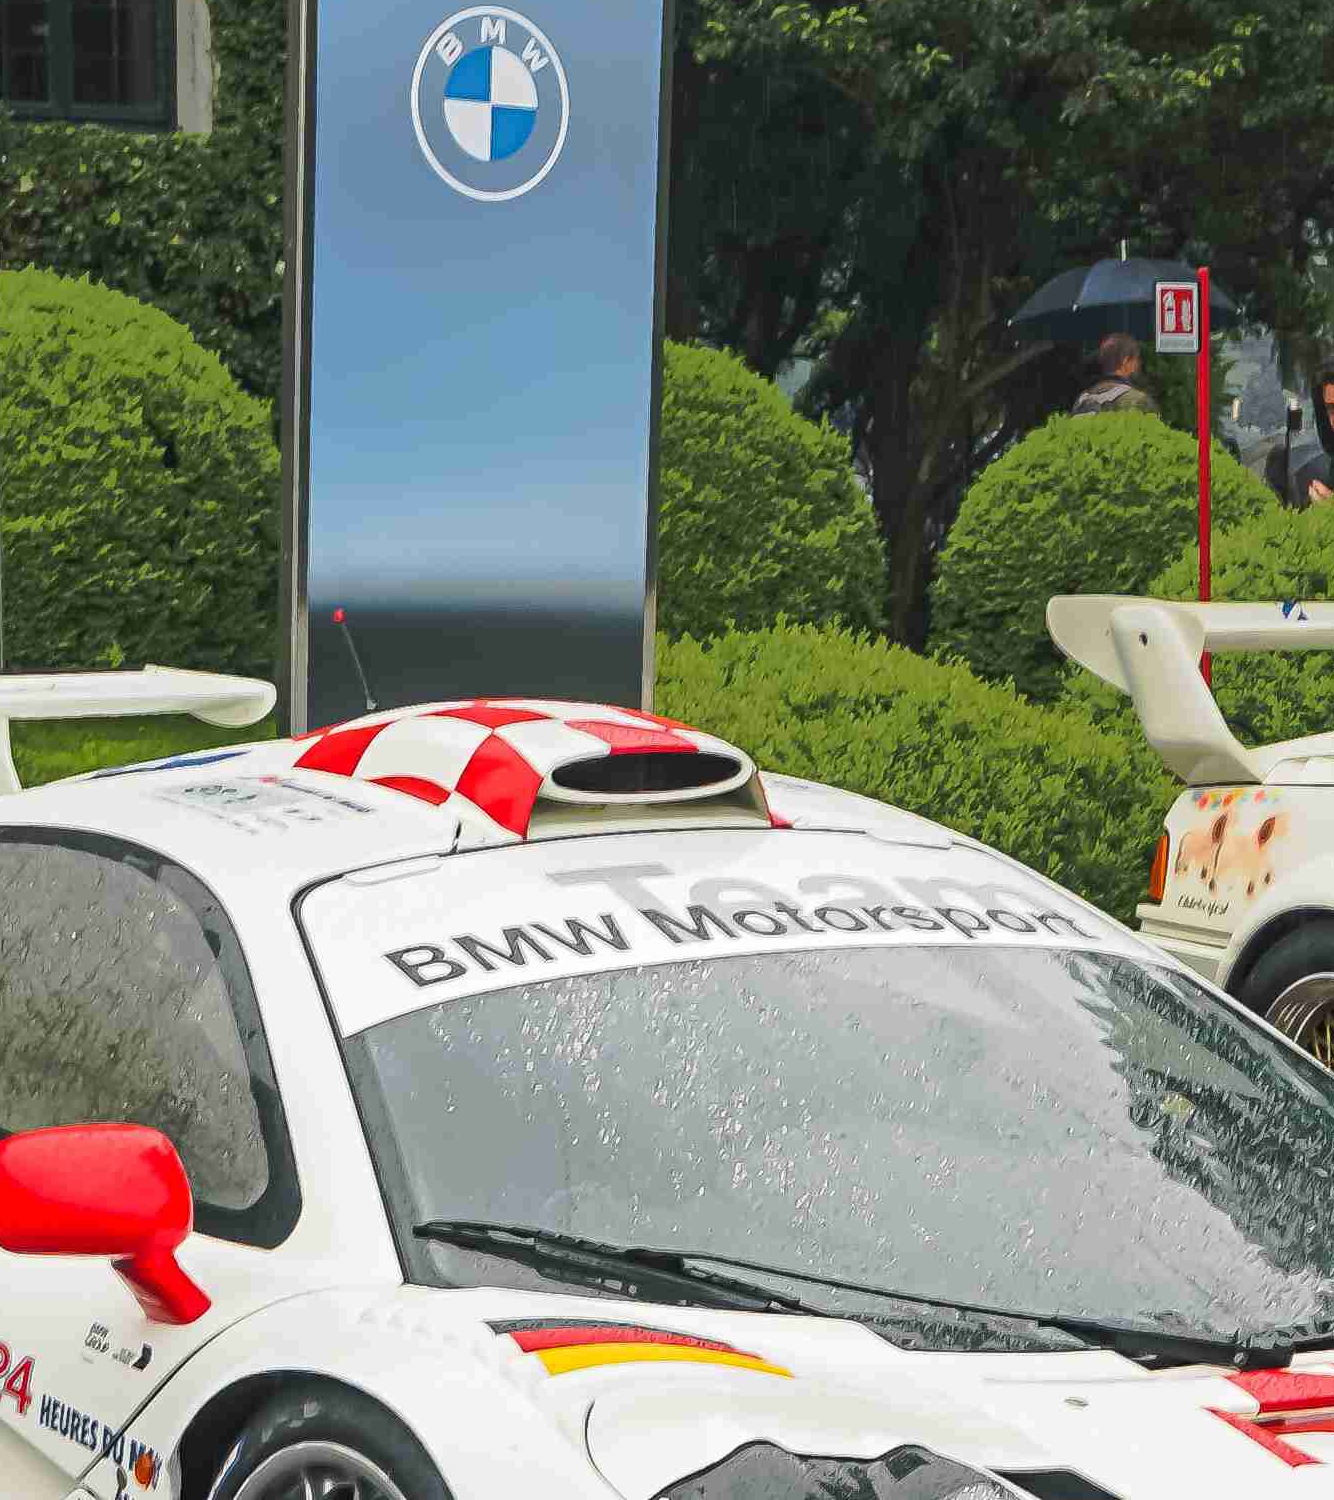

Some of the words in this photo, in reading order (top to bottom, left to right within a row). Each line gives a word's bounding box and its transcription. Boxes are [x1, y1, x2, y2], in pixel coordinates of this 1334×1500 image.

[435, 16, 549, 73] BMW
[545, 862, 1055, 934] Team
[384, 912, 632, 988] BMW
[641, 898, 1103, 946] Motorsport
[38, 1394, 100, 1453] HEURES
